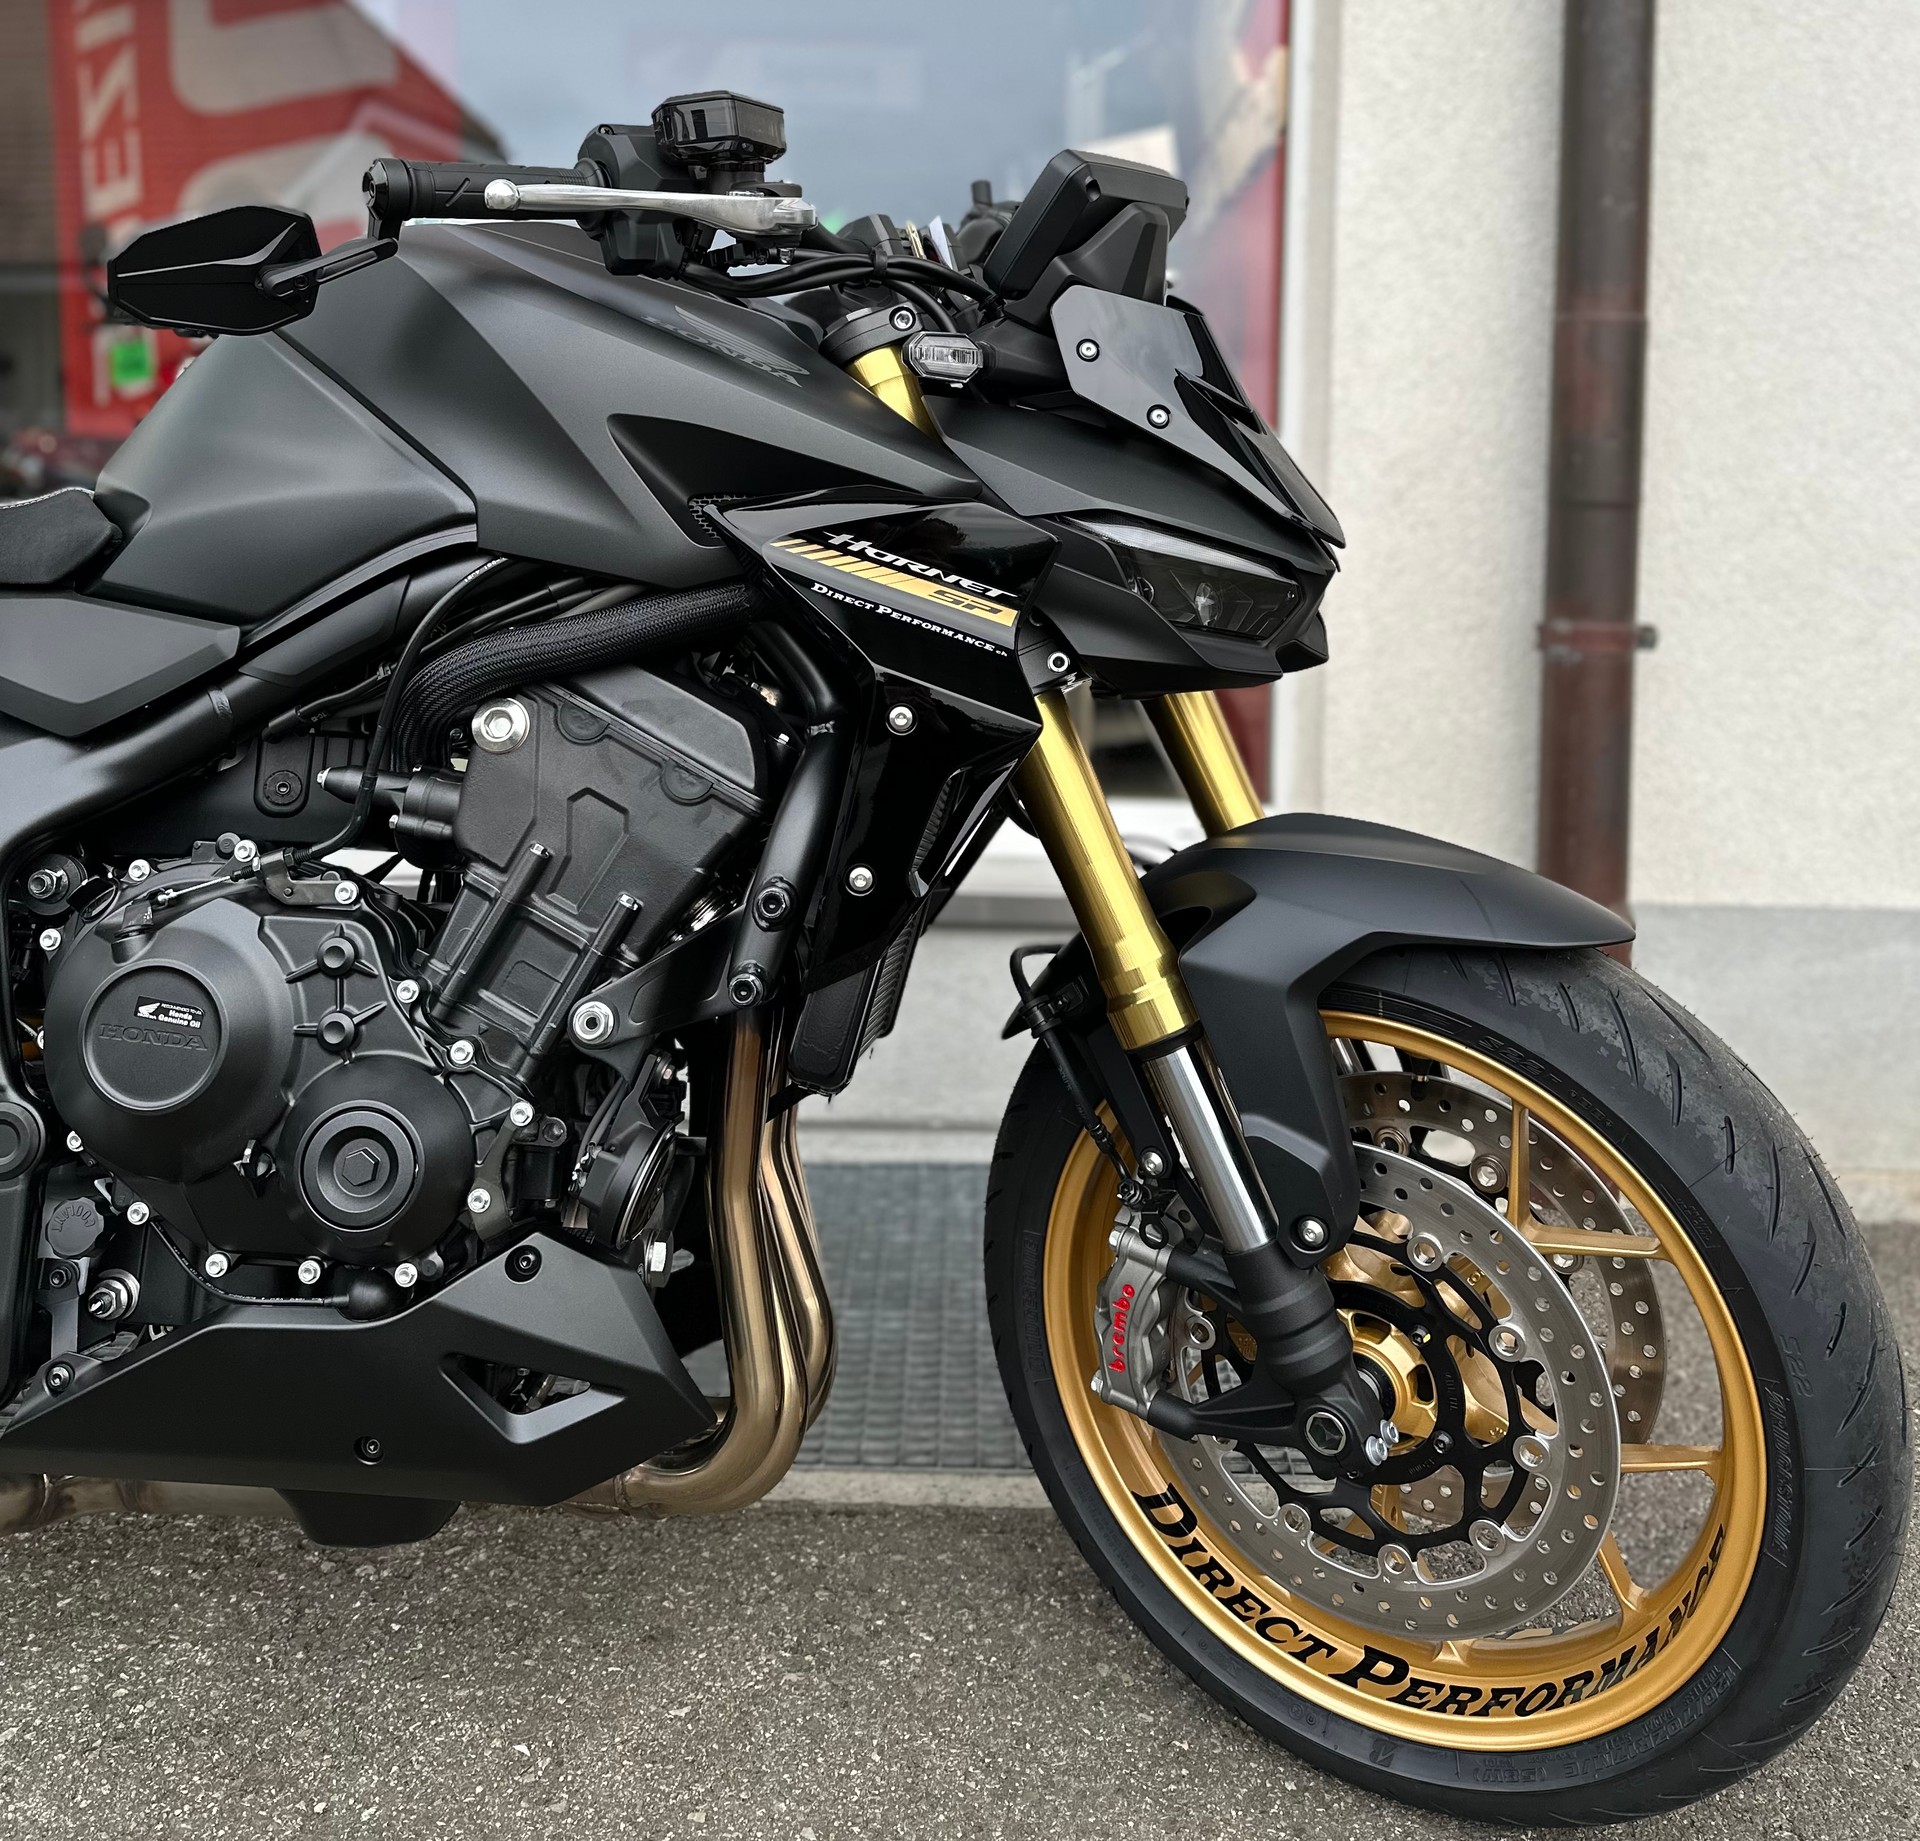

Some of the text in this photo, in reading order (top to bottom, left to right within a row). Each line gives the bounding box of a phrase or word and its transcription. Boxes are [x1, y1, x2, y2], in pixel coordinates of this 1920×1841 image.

[640, 314, 803, 388] HONDA
[822, 530, 1018, 598] HORNET
[811, 582, 875, 610] DIRECT
[928, 589, 1004, 615] SP
[158, 1013, 201, 1029] Genuine Oil
[168, 1009, 193, 1021] Honda
[98, 1023, 208, 1051] HONDA
[1107, 1283, 1136, 1374] brembo
[1131, 1482, 1338, 1664] DIRECT
[1327, 1523, 1727, 1718] PERFORMANCE
